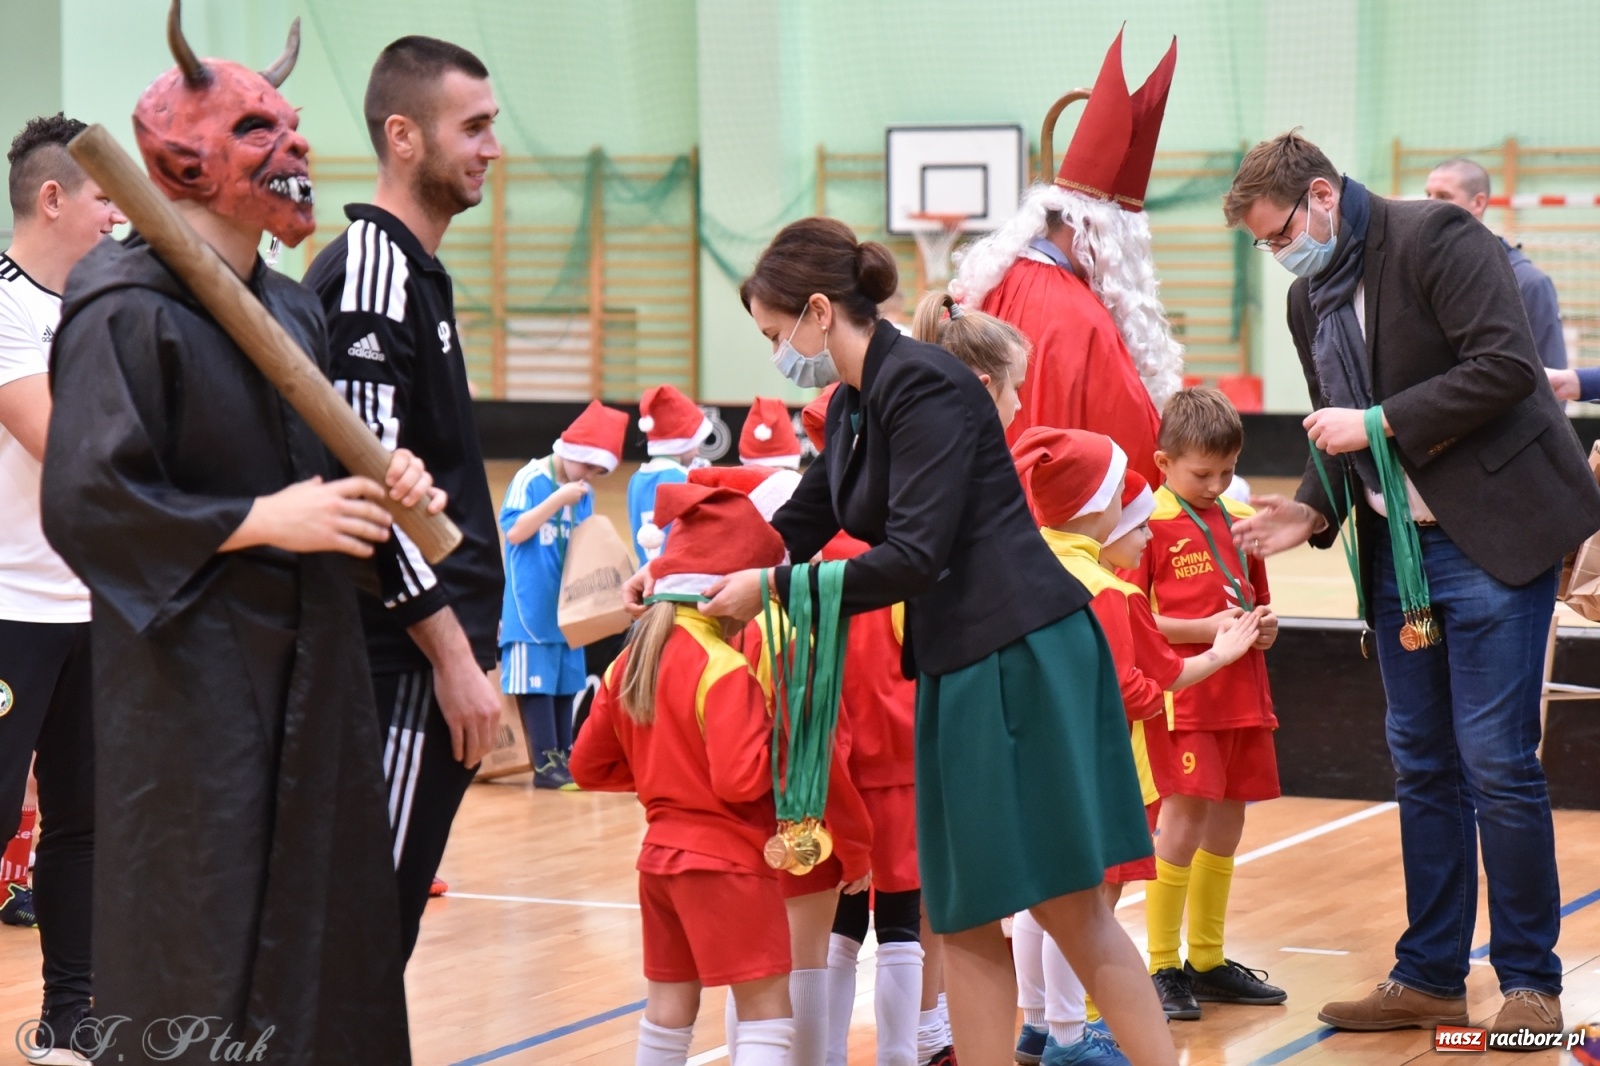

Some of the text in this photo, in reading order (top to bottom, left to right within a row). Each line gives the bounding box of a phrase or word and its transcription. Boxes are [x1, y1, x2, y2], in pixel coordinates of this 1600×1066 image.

[347, 346, 385, 361] adidas
[1171, 550, 1211, 568] GMINA
[1174, 562, 1215, 580] NĘDZA
[1181, 751, 1196, 775] 9
